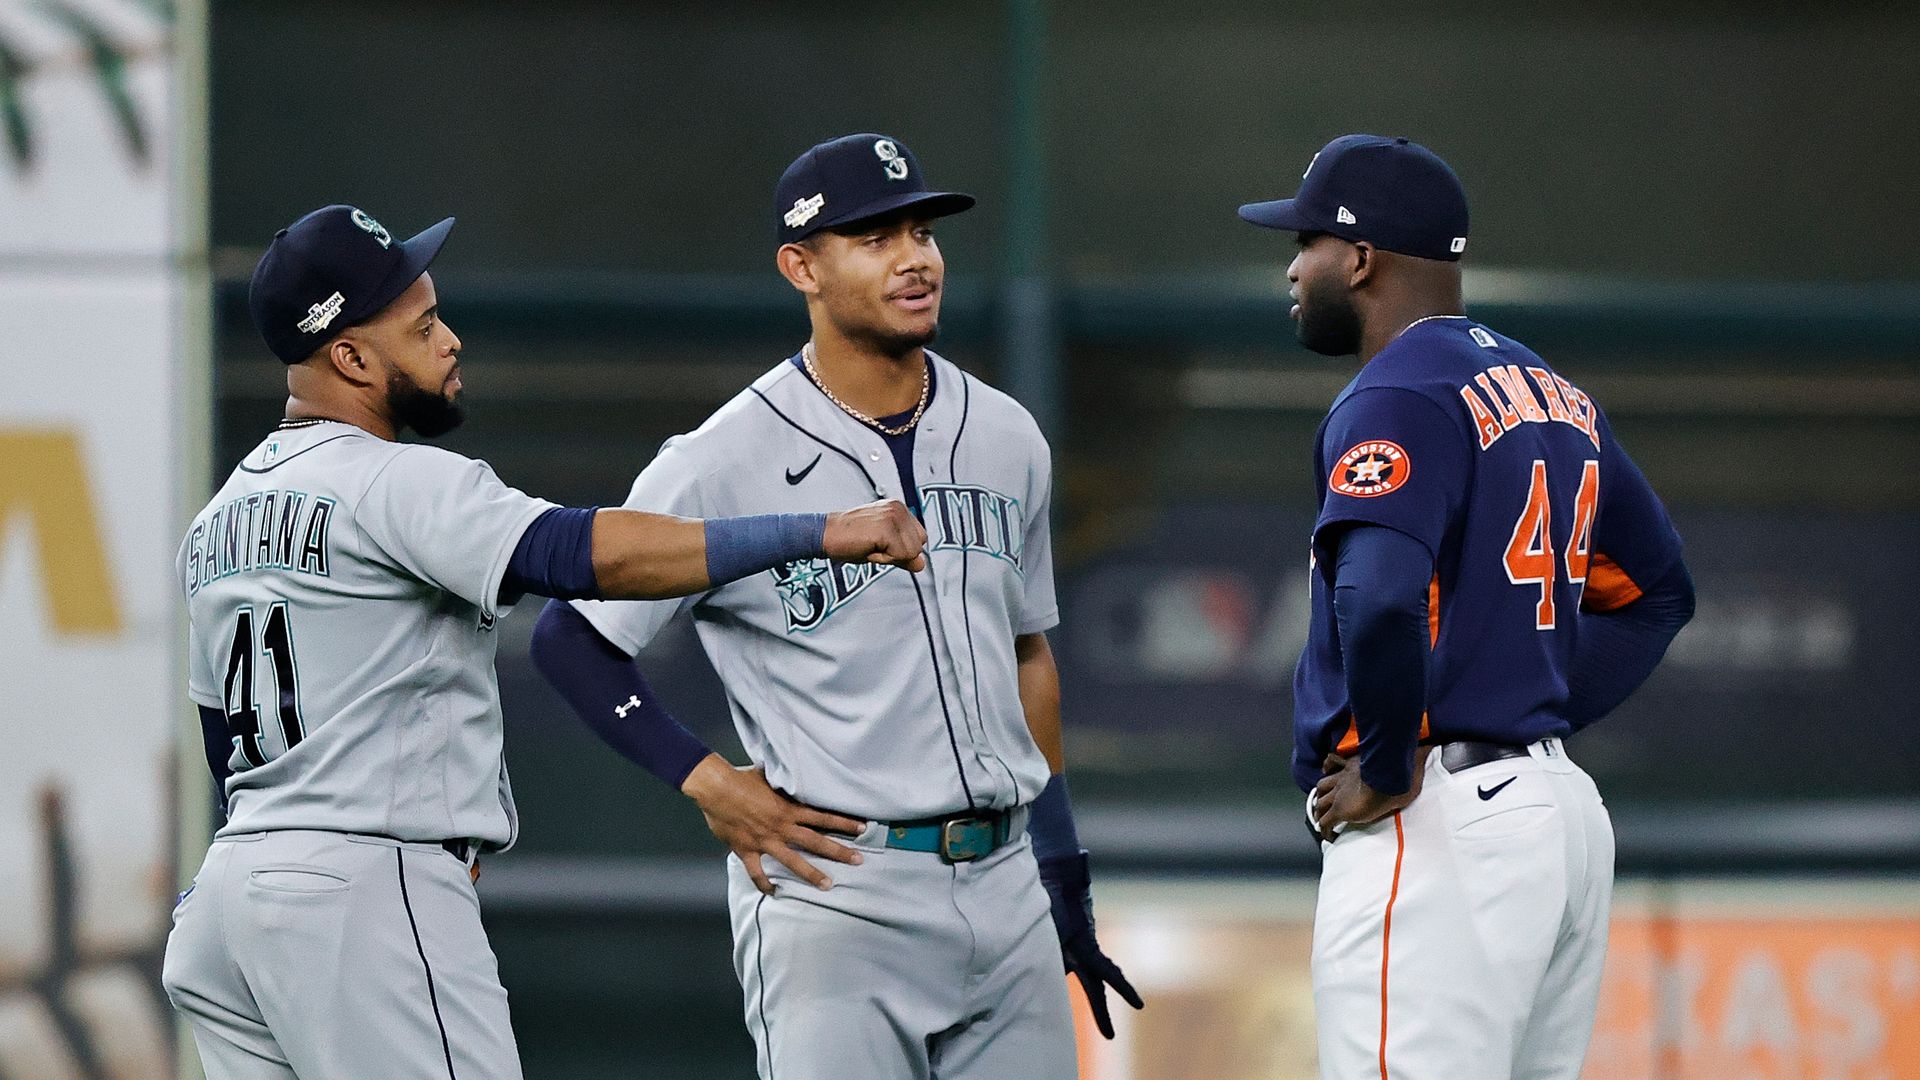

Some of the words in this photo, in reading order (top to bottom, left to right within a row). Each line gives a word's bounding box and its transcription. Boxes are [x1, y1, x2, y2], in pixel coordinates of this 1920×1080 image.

[300, 295, 342, 332] POSTSEASON
[1459, 364, 1601, 452] ALVAREZ
[1337, 481, 1392, 495] ASTROS
[1341, 443, 1402, 466] HOUSTON
[188, 489, 336, 598] SANTANA
[1502, 459, 1600, 630] 44
[223, 600, 307, 768] 41
